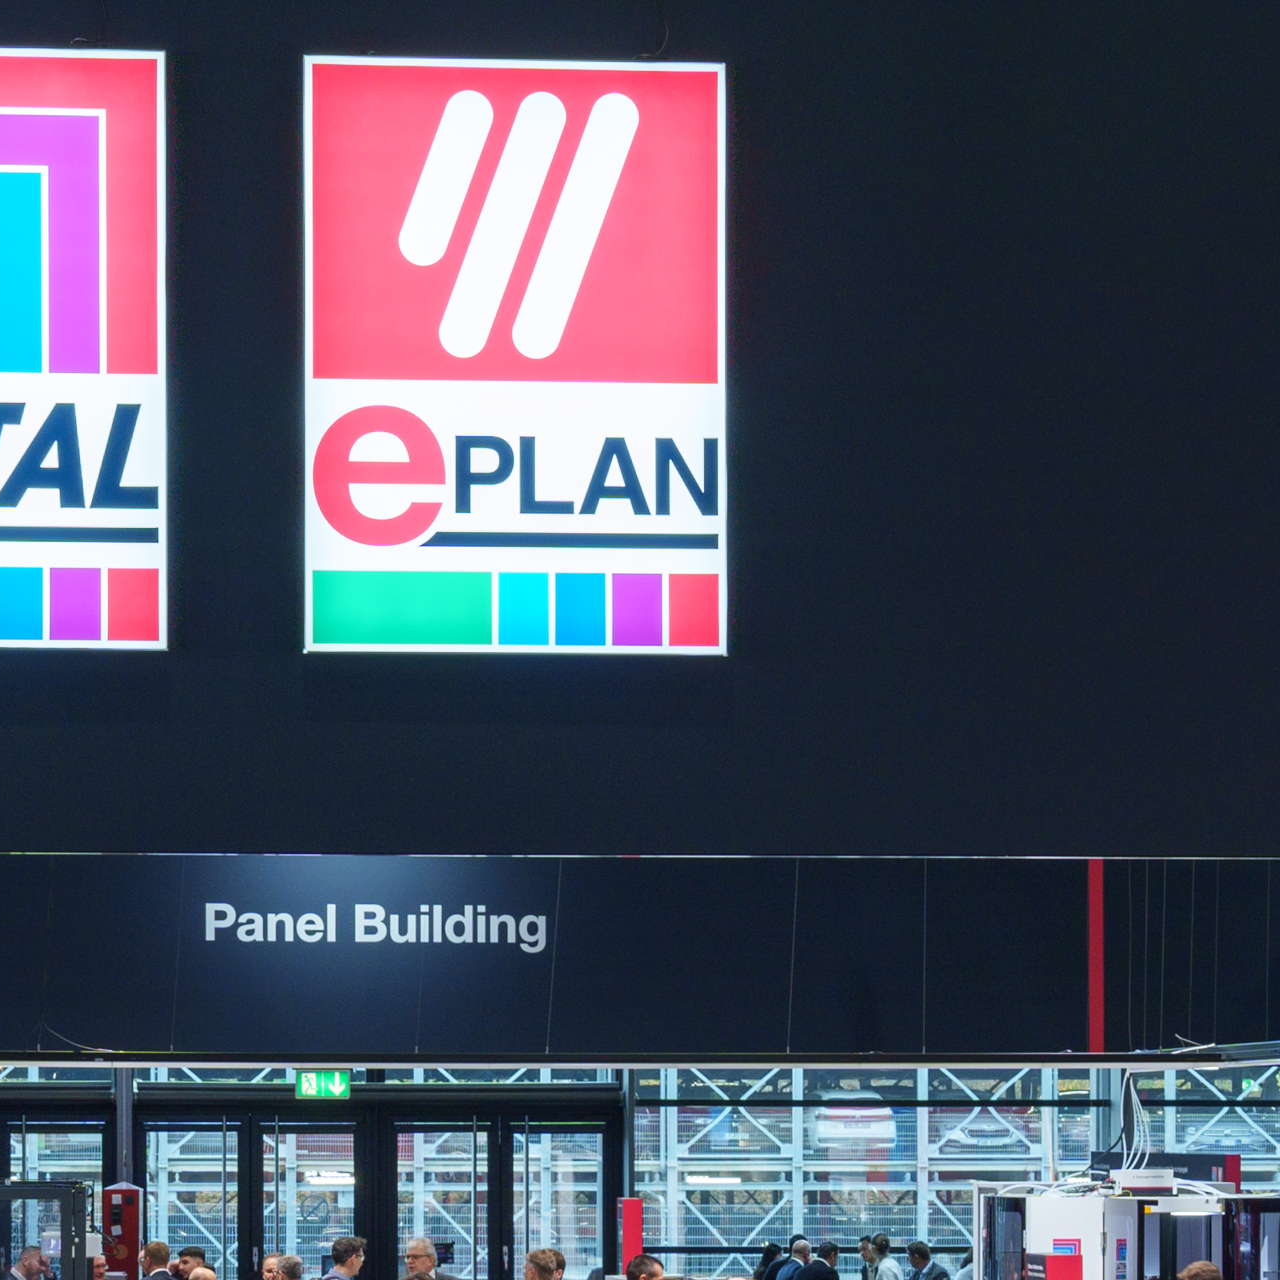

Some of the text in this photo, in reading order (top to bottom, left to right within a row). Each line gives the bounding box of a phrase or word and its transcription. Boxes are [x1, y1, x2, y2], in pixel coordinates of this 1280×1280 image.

[313, 404, 719, 547] ePLAN
[205, 903, 547, 954] Panel Building
